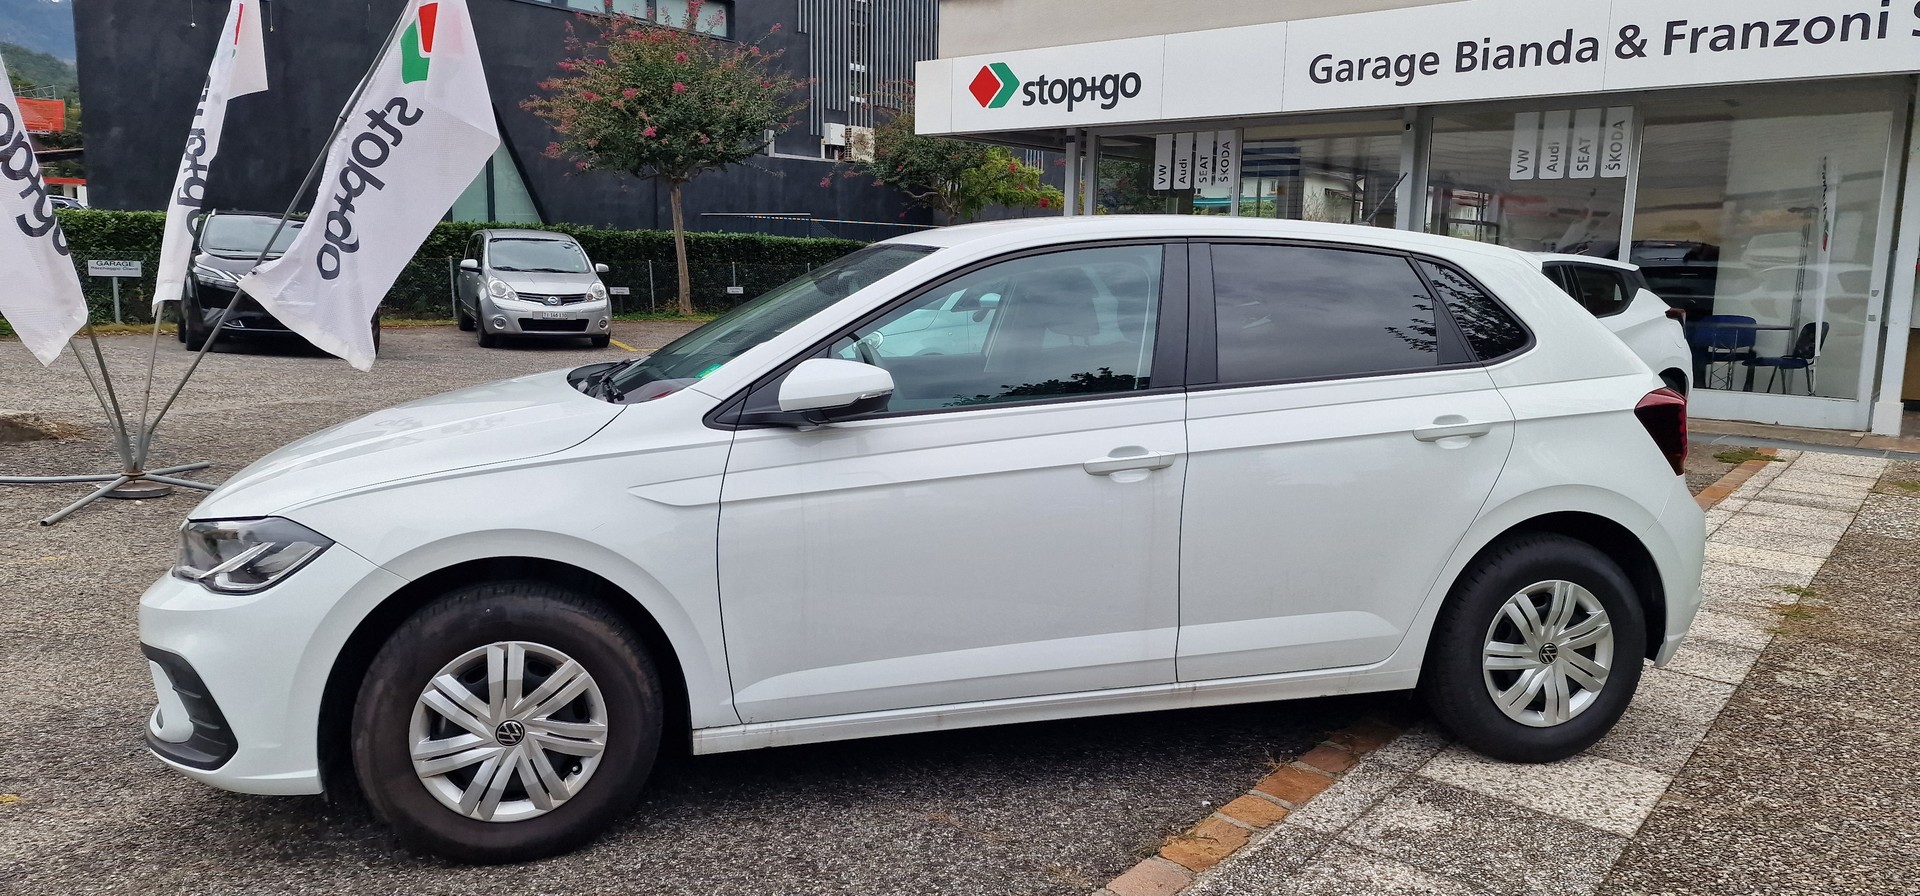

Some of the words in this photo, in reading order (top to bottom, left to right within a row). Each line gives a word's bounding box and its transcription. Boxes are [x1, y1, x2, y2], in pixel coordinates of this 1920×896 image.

[1308, 52, 1441, 87] Garage
[1455, 27, 1600, 74] Bianda
[1614, 23, 1649, 60] &
[1663, 0, 1891, 56] Franzoni
[1022, 71, 1142, 112] stop+go
[1218, 140, 1231, 183] ŠKODA
[1516, 149, 1530, 174] VW
[1546, 141, 1560, 173] Audi
[1576, 137, 1592, 172] SEAT
[1604, 119, 1626, 171] ŠKODA
[1158, 164, 1168, 185] VW
[1178, 158, 1188, 184] Audi
[1198, 154, 1209, 184] SEAT
